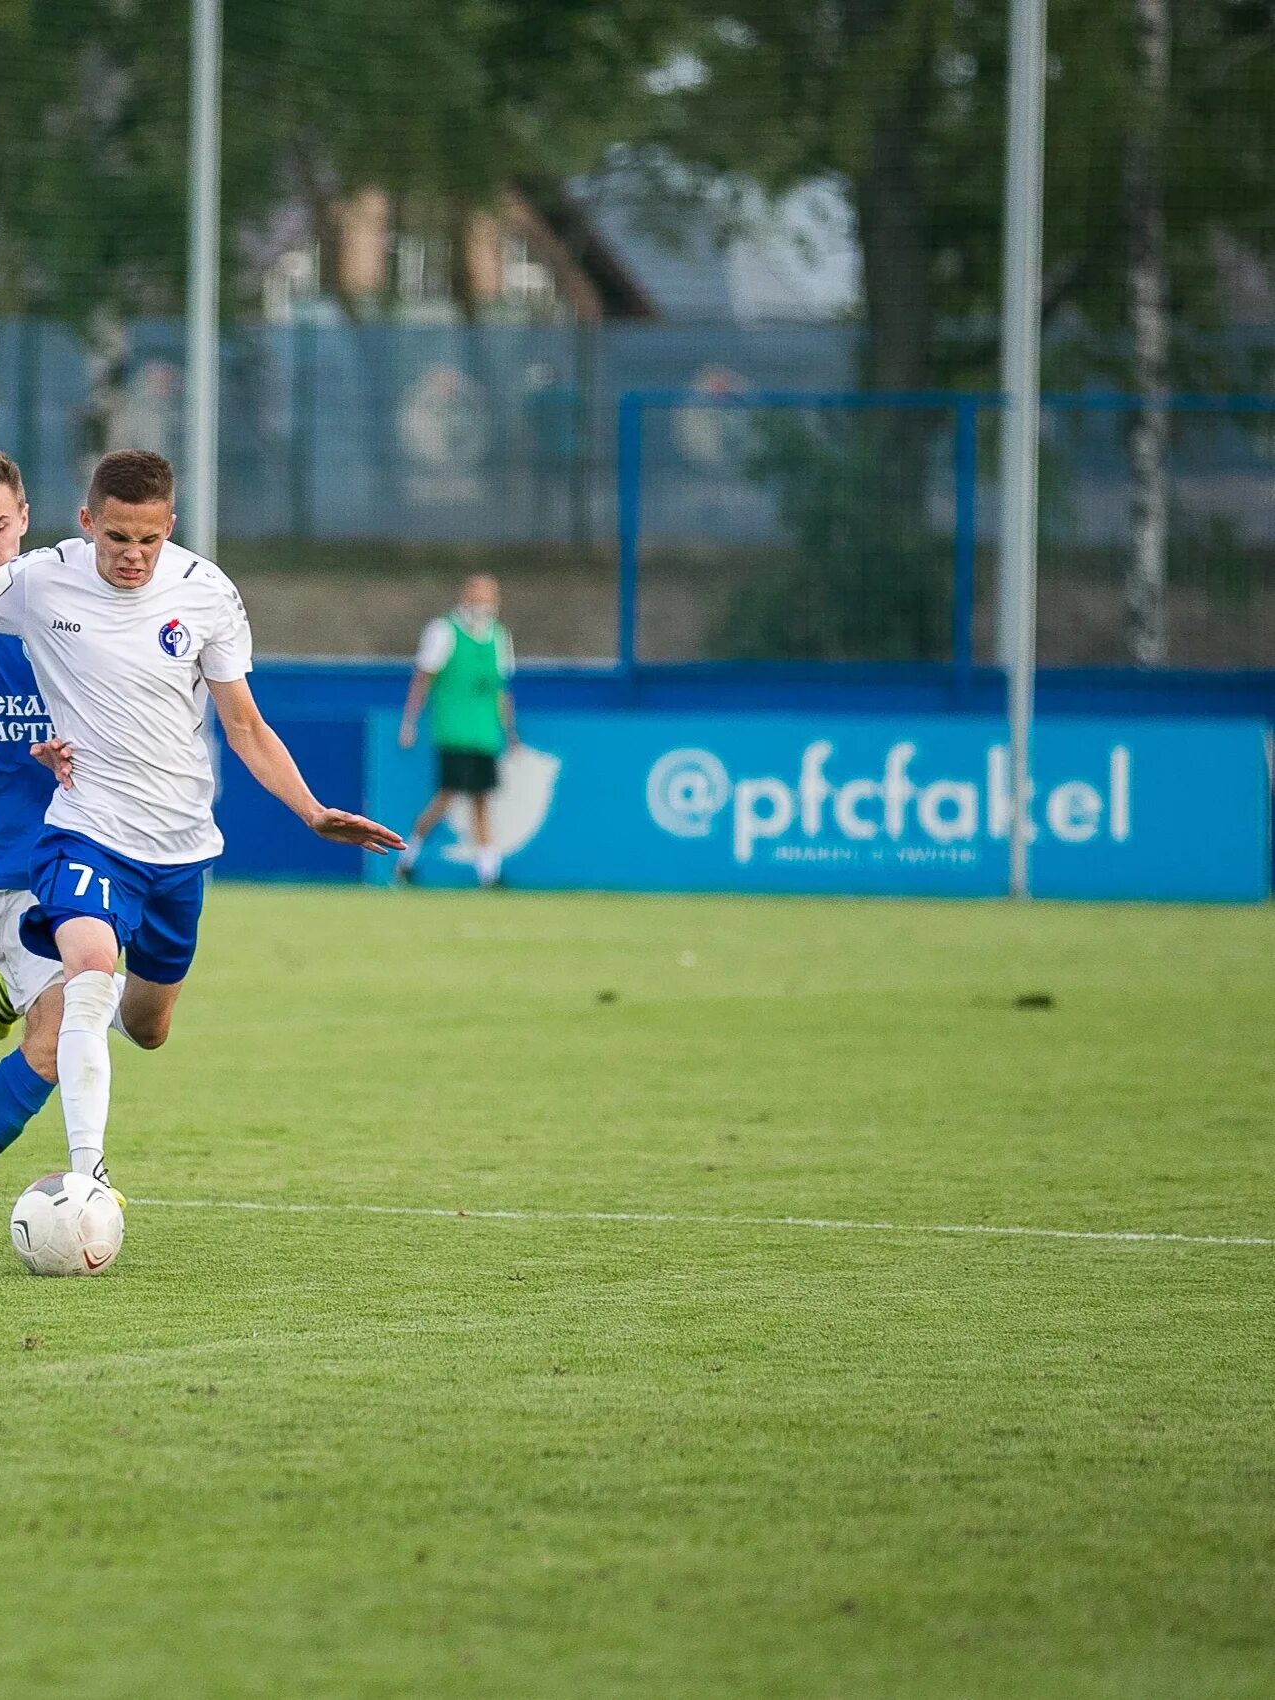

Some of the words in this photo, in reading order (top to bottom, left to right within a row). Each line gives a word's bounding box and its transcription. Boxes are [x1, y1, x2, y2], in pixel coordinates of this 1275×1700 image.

[52, 619, 81, 633] JAKO
[646, 740, 1130, 863] @pfcfakel
[68, 863, 110, 910] 71
